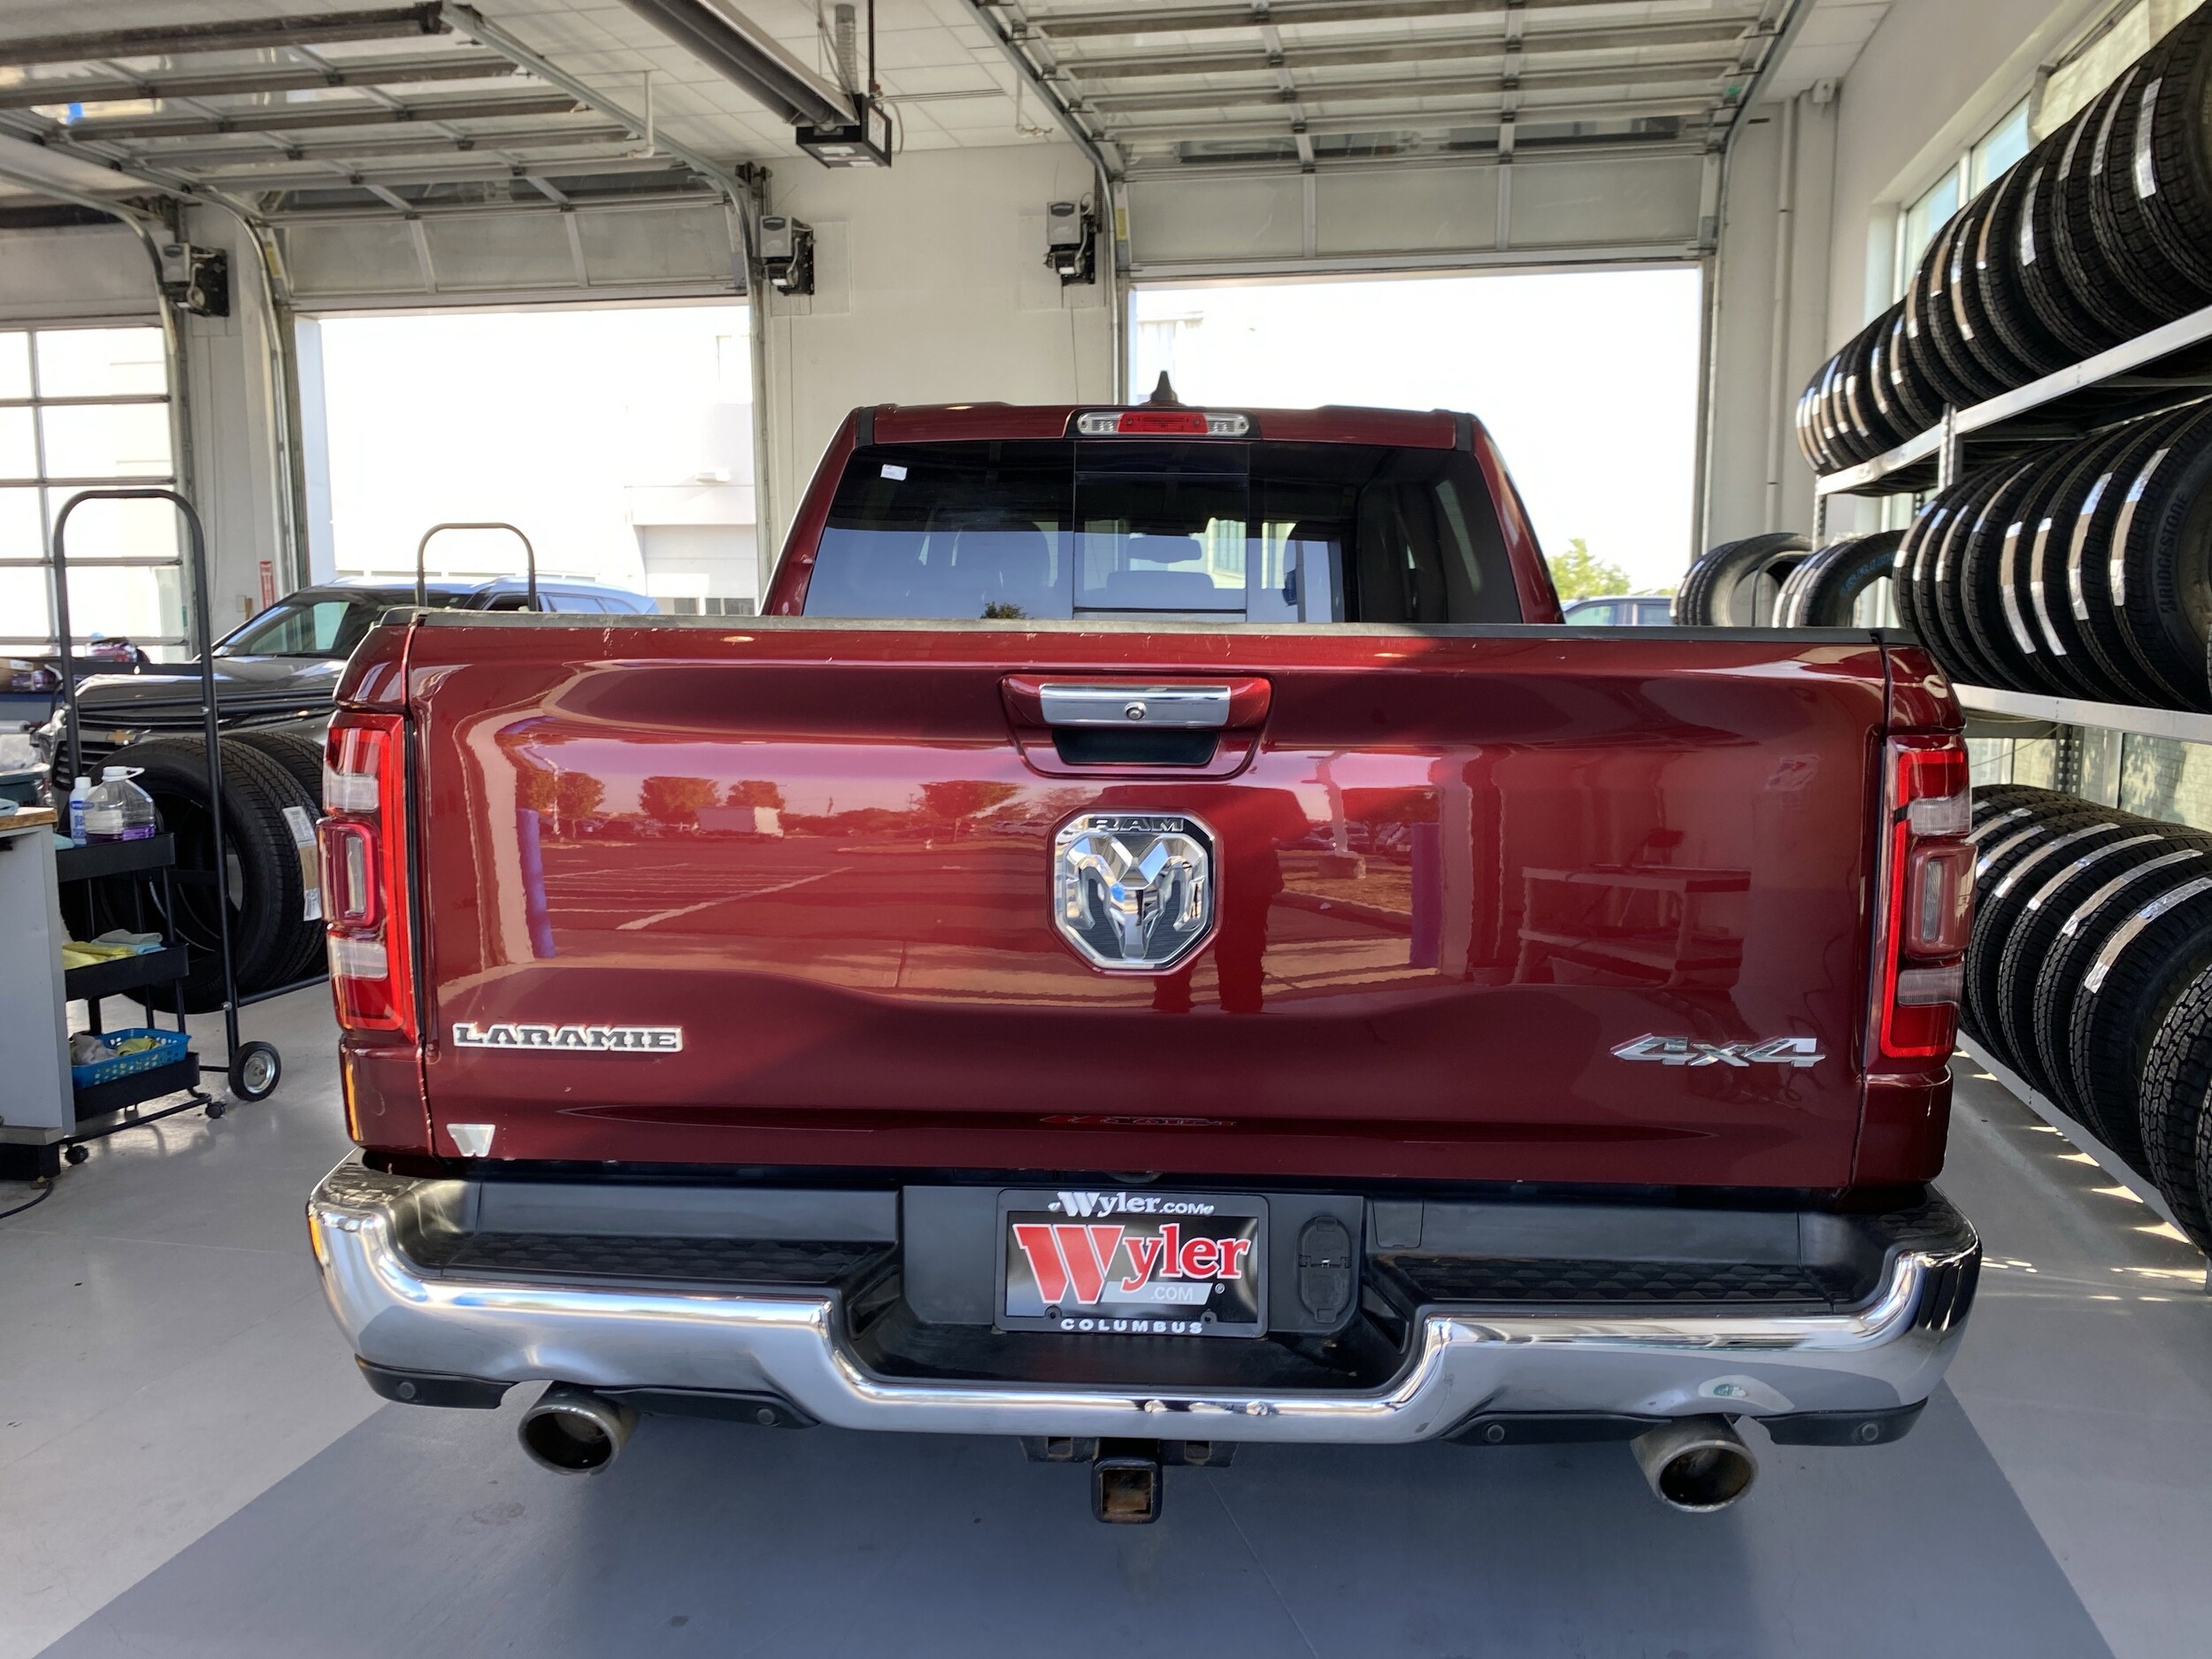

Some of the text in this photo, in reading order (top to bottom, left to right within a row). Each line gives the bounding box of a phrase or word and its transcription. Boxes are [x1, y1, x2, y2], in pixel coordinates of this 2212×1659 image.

[1088, 818, 1184, 832] RAM
[453, 1022, 683, 1052] LARAMIE
[1012, 1223, 1251, 1304] Wyler
[1060, 1317, 1203, 1334] COLUMBUS
